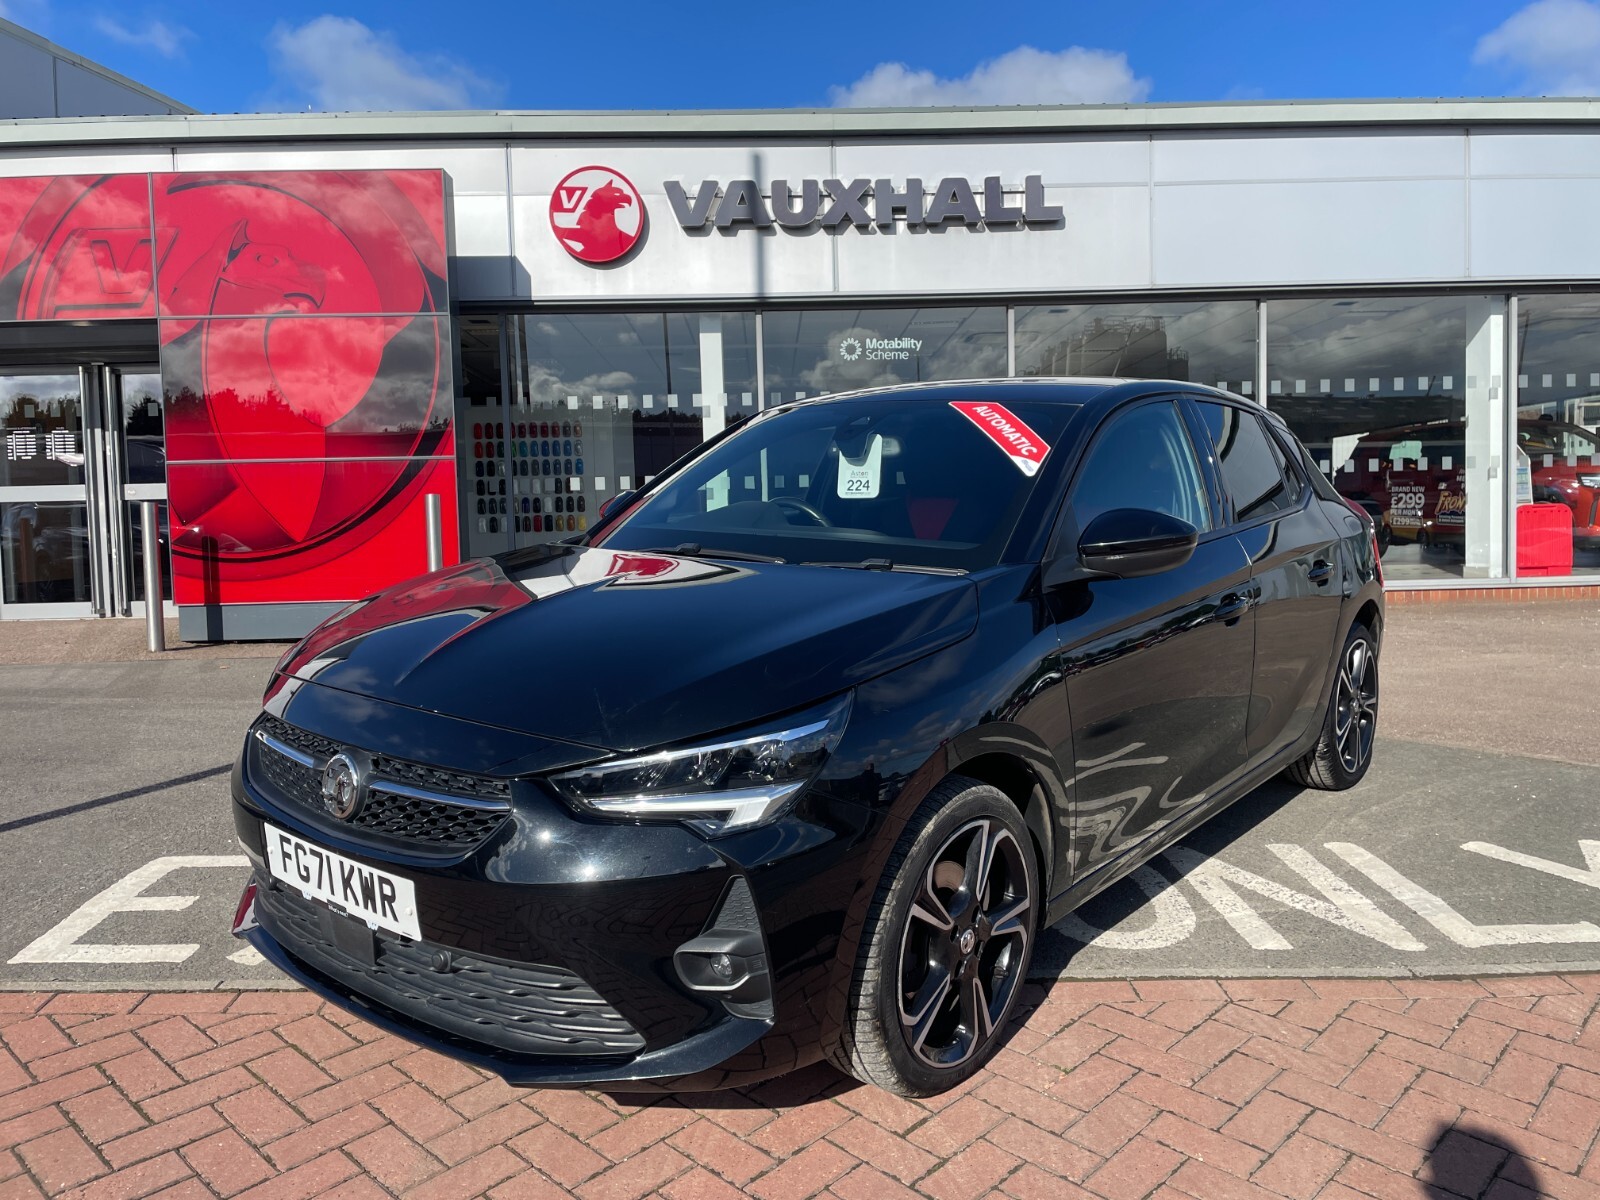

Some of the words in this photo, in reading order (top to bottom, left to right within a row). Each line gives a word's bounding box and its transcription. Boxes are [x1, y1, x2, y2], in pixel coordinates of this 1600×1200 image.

[663, 174, 1063, 227] VAUXHALL
[865, 337, 922, 351] Motability
[865, 349, 910, 360] Scheme
[972, 405, 1038, 456] AUTOMATIC
[846, 479, 870, 492] 224
[1390, 493, 1425, 509] £299
[279, 833, 336, 897] FG71
[338, 859, 400, 924] KWR
